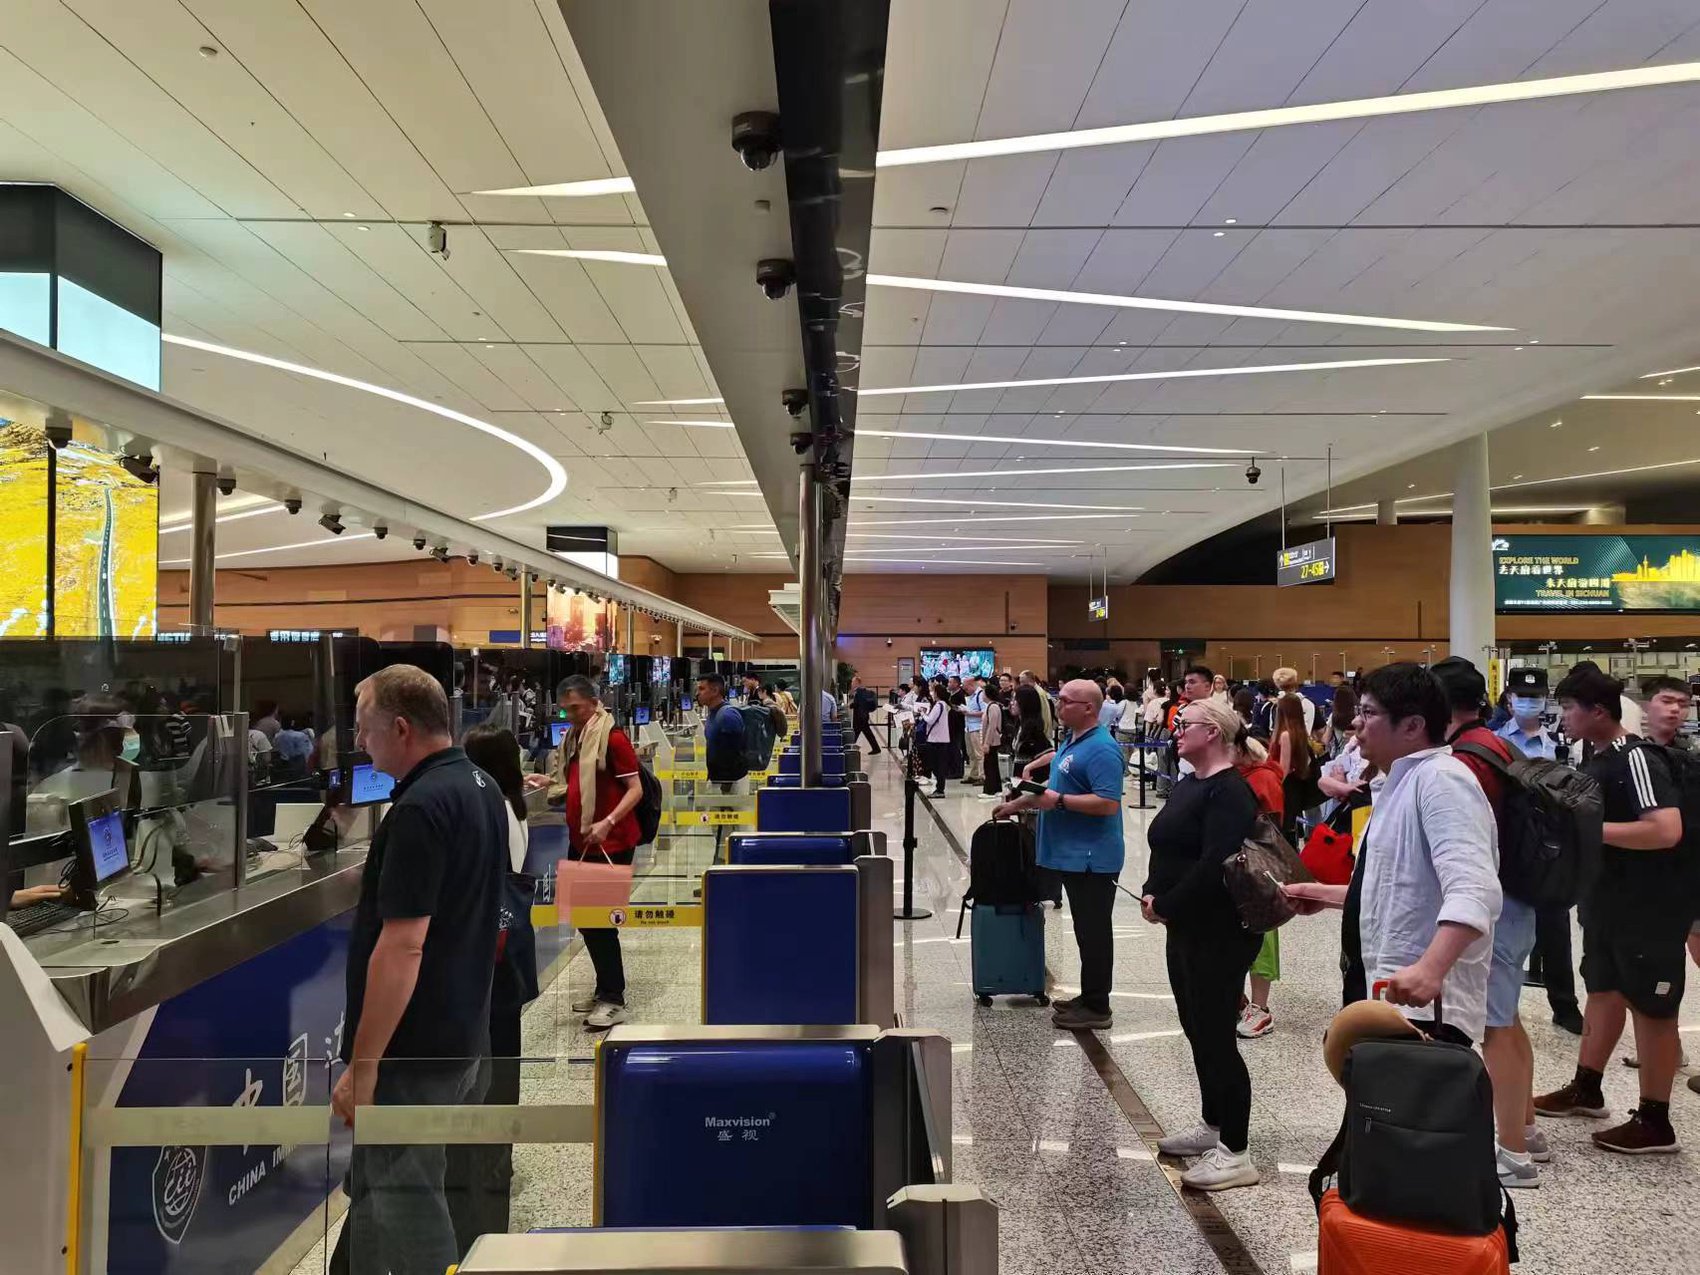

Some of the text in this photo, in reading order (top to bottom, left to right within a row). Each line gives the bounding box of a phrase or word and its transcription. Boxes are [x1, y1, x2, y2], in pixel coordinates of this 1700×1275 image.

[705, 1116, 770, 1128] Maxvision
[717, 1129, 759, 1141] 盛视
[228, 1159, 267, 1206] CHINA
